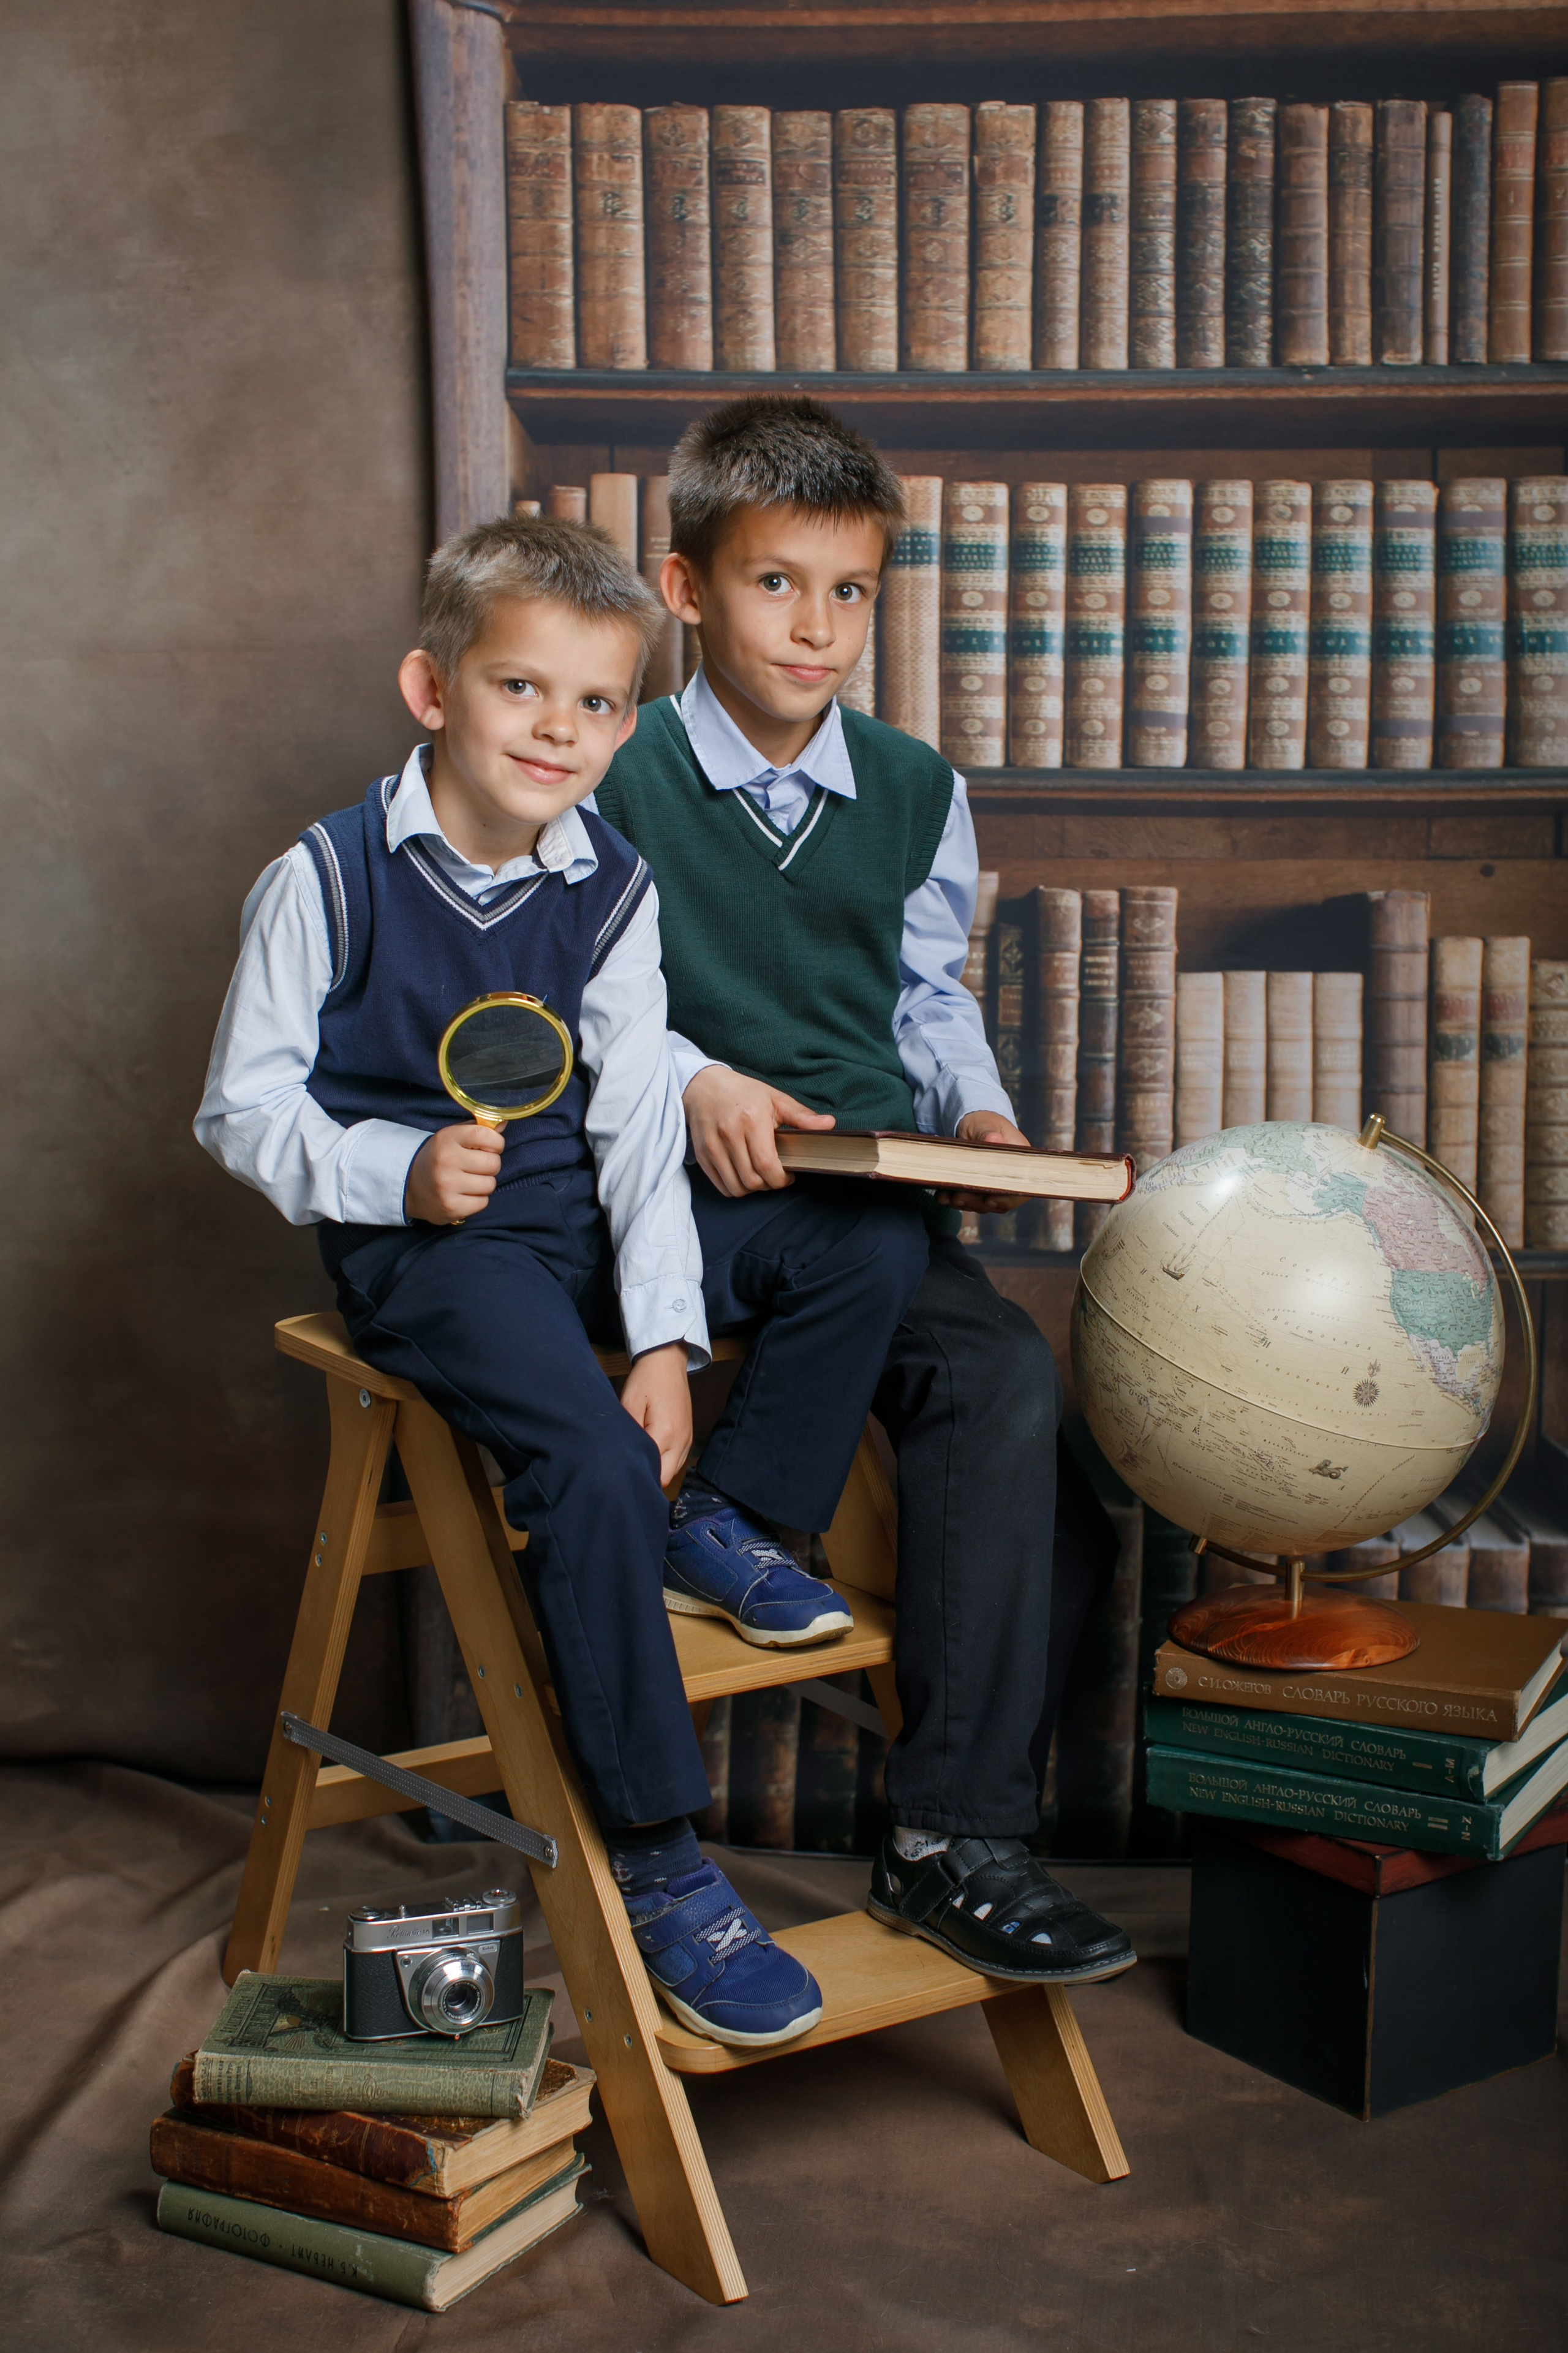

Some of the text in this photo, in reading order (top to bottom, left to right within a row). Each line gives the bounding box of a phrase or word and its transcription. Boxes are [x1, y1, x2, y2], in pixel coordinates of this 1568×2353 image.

[1282, 1686, 1350, 1704] СЛОВАРЬ
[1357, 1693, 1438, 1715] РУССКОГО
[1442, 1704, 1498, 1722] ЯЗЫКА
[1182, 1707, 1406, 1760] БОЛЬШОЙ АНГЛО-РУССКИЙ СЛОВАРЬ
[1183, 1721, 1395, 1772] NEW ENGLISH-RUSSIAN DICTIONARY
[1188, 1772, 1422, 1819] БОЛЬШОЙ АНГЛО-РУССКИЙ СЛОВАРЬ
[1189, 1786, 1409, 1831] NEW ENGLISH-RUSSIAN DICTIONARY
[187, 2207, 270, 2248] ФОТОГРАФИЯ
